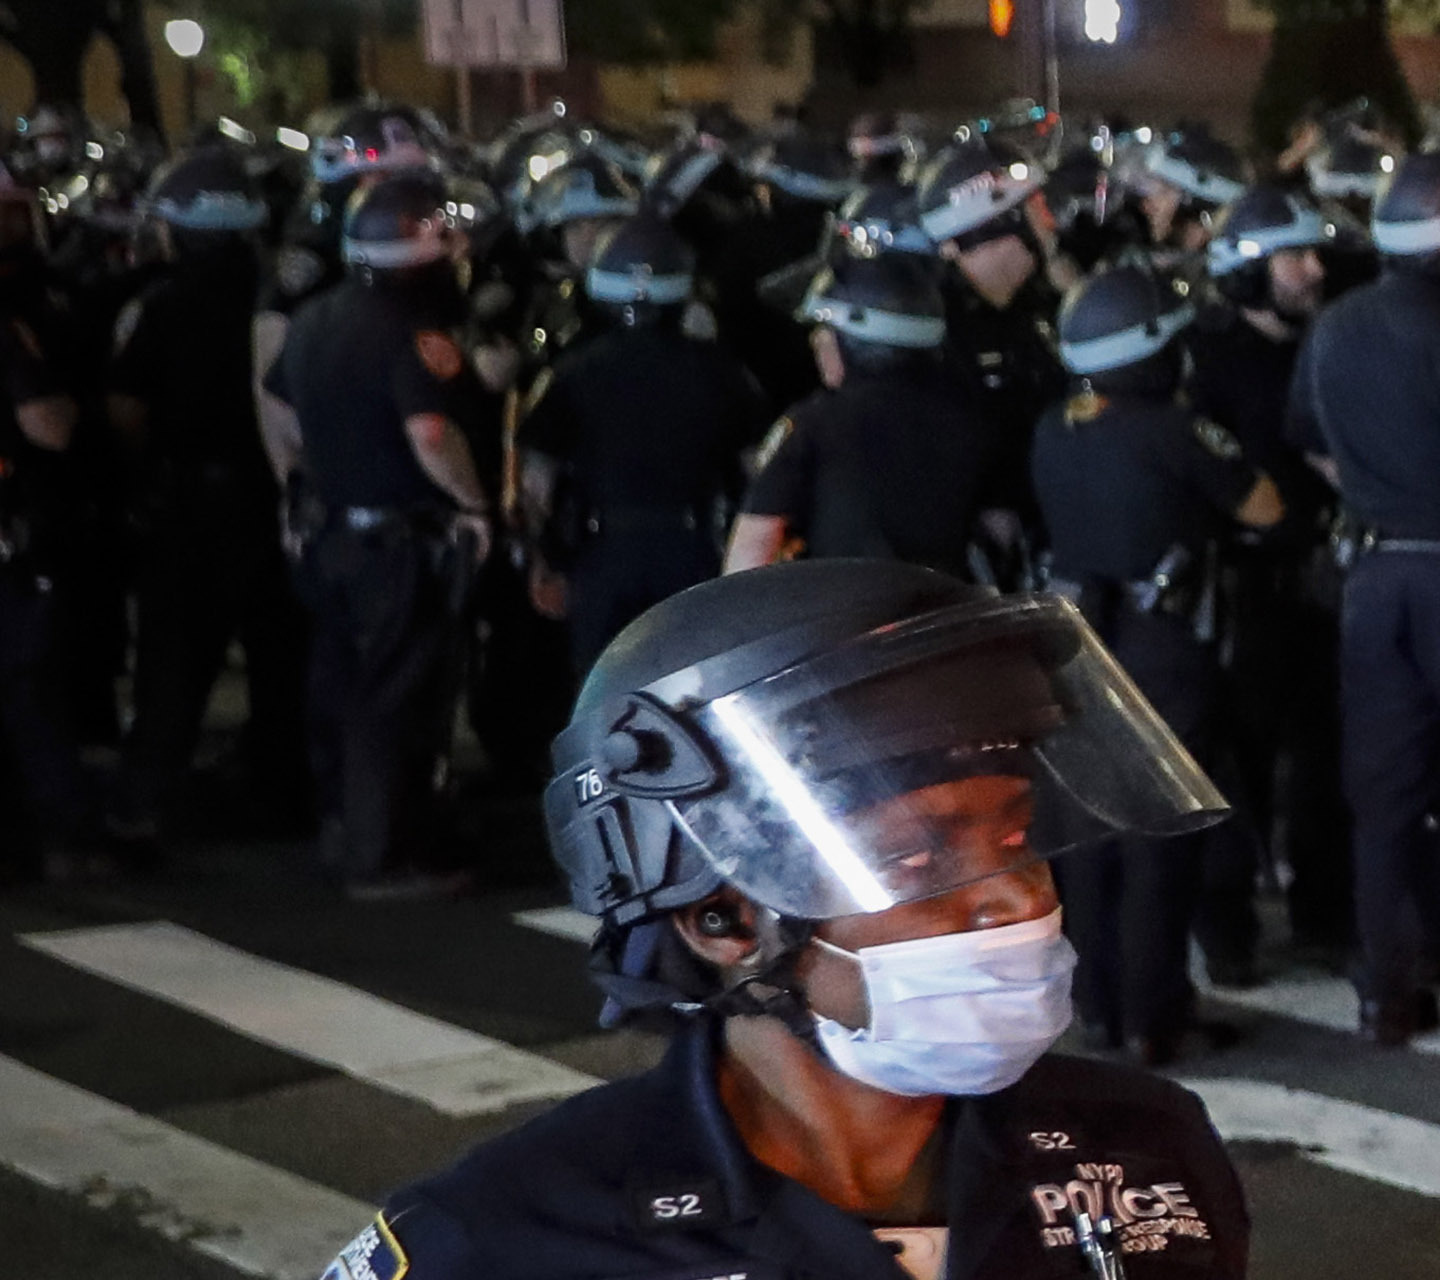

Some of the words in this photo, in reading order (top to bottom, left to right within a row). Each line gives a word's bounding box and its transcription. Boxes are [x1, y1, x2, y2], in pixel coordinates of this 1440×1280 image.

[576, 768, 603, 800] 76
[1029, 1131, 1077, 1149] S2
[652, 1194, 703, 1218] S2
[1032, 1179, 1199, 1228] POLICE
